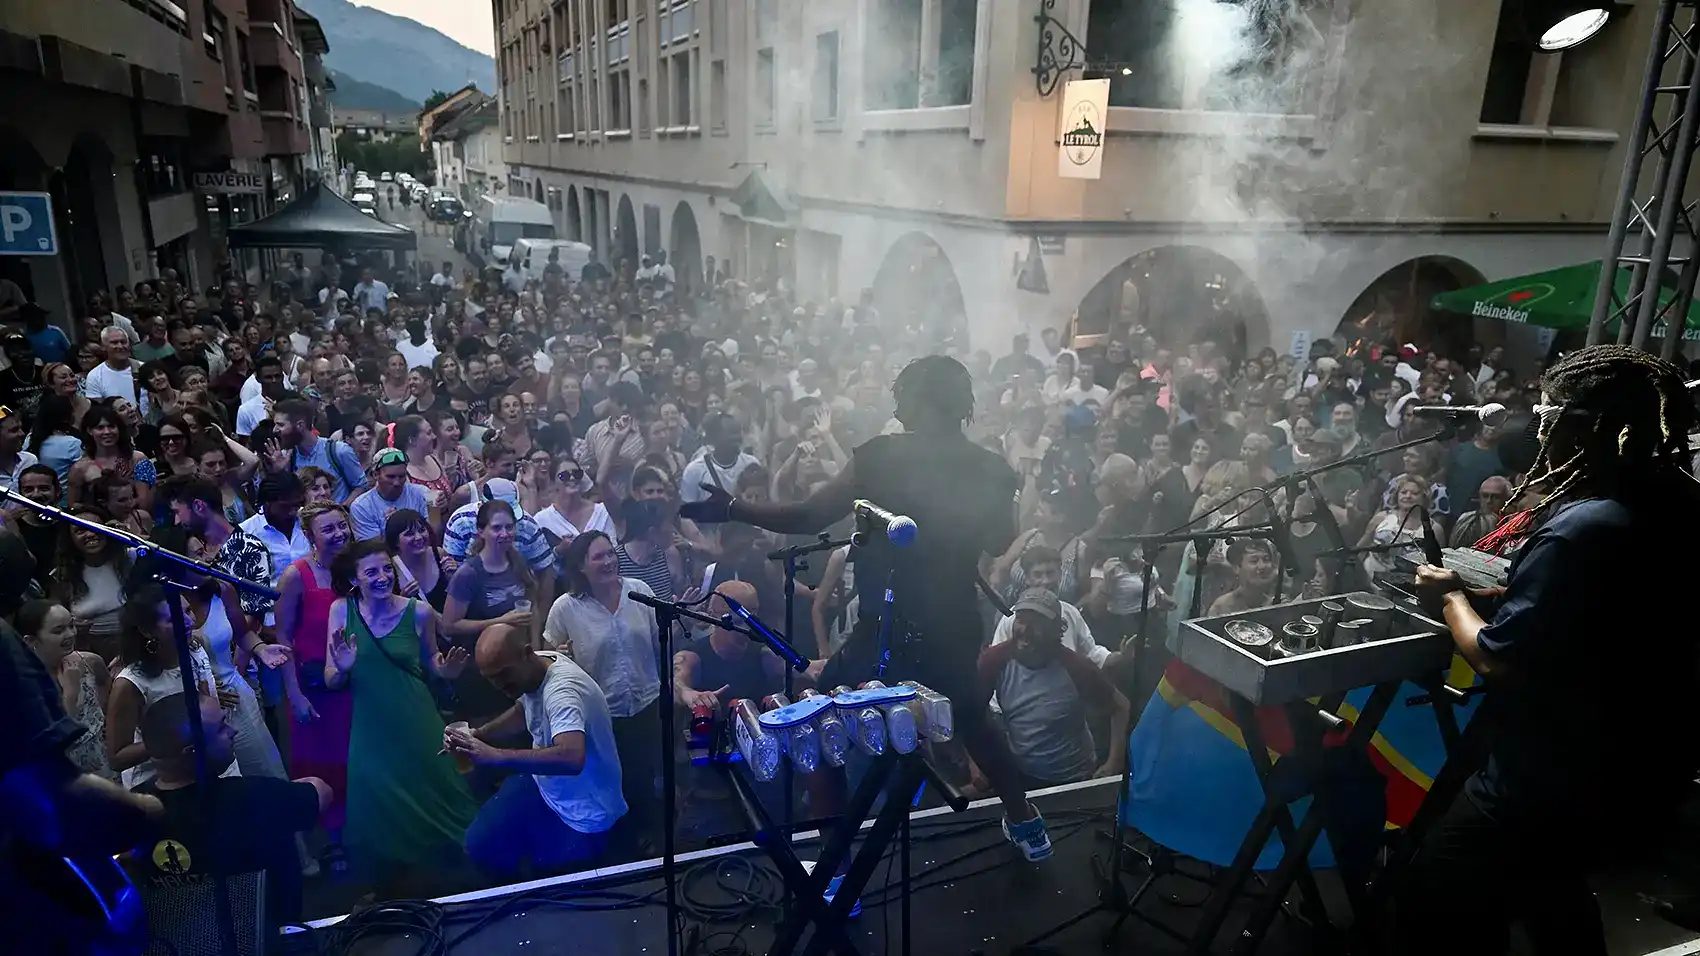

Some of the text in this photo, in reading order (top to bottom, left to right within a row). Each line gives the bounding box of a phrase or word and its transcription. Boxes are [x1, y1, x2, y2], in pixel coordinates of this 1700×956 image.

[1066, 134, 1099, 146] LE TYROL
[195, 174, 263, 187] LAVERIE
[0, 205, 32, 243] P
[1471, 301, 1529, 323] Heineken
